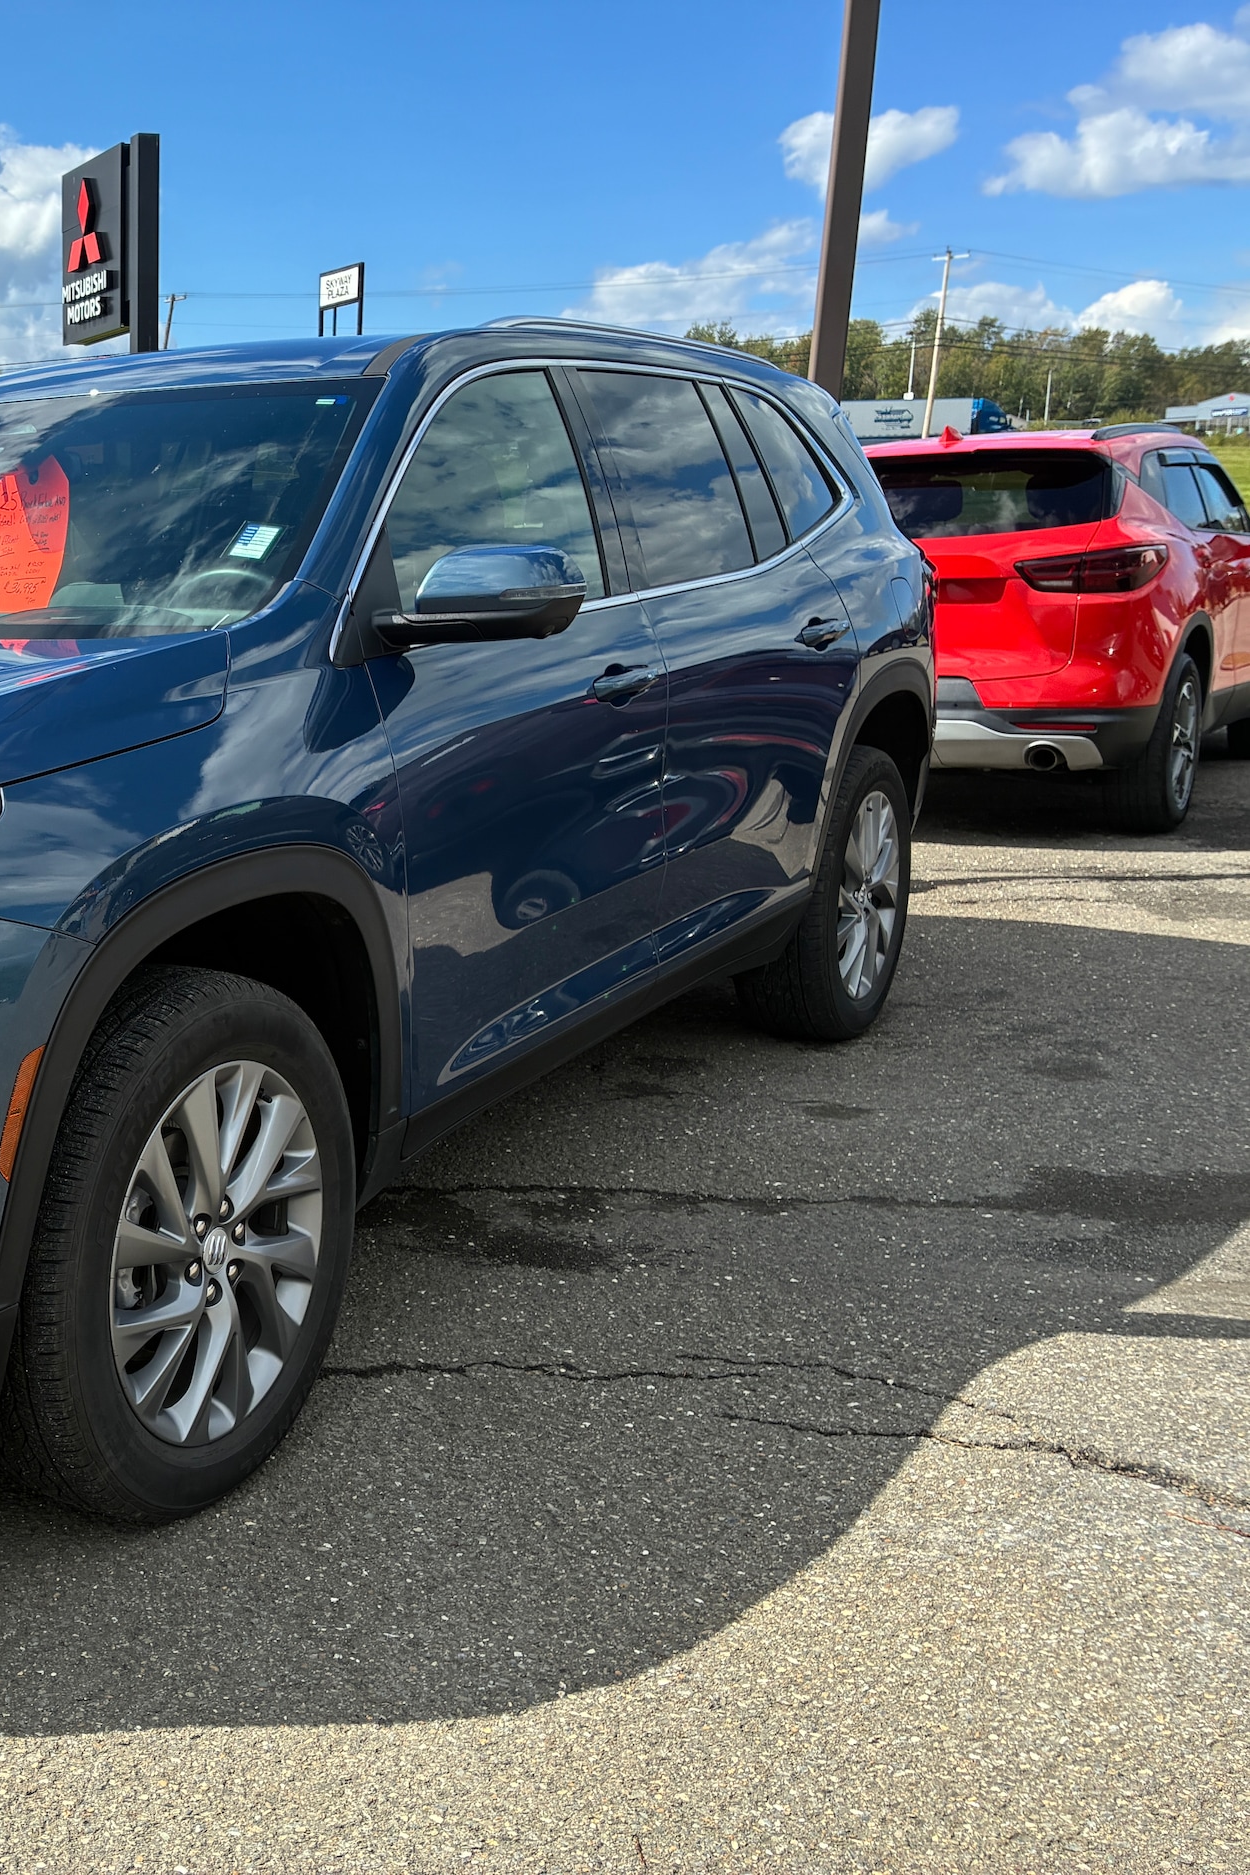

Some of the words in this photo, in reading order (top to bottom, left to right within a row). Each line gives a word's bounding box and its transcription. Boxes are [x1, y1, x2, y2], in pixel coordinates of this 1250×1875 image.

[62, 269, 107, 304] MITSUBISHI
[325, 273, 352, 290] SKYWAY
[327, 285, 350, 300] PLAZA
[67, 296, 101, 325] MOTORS
